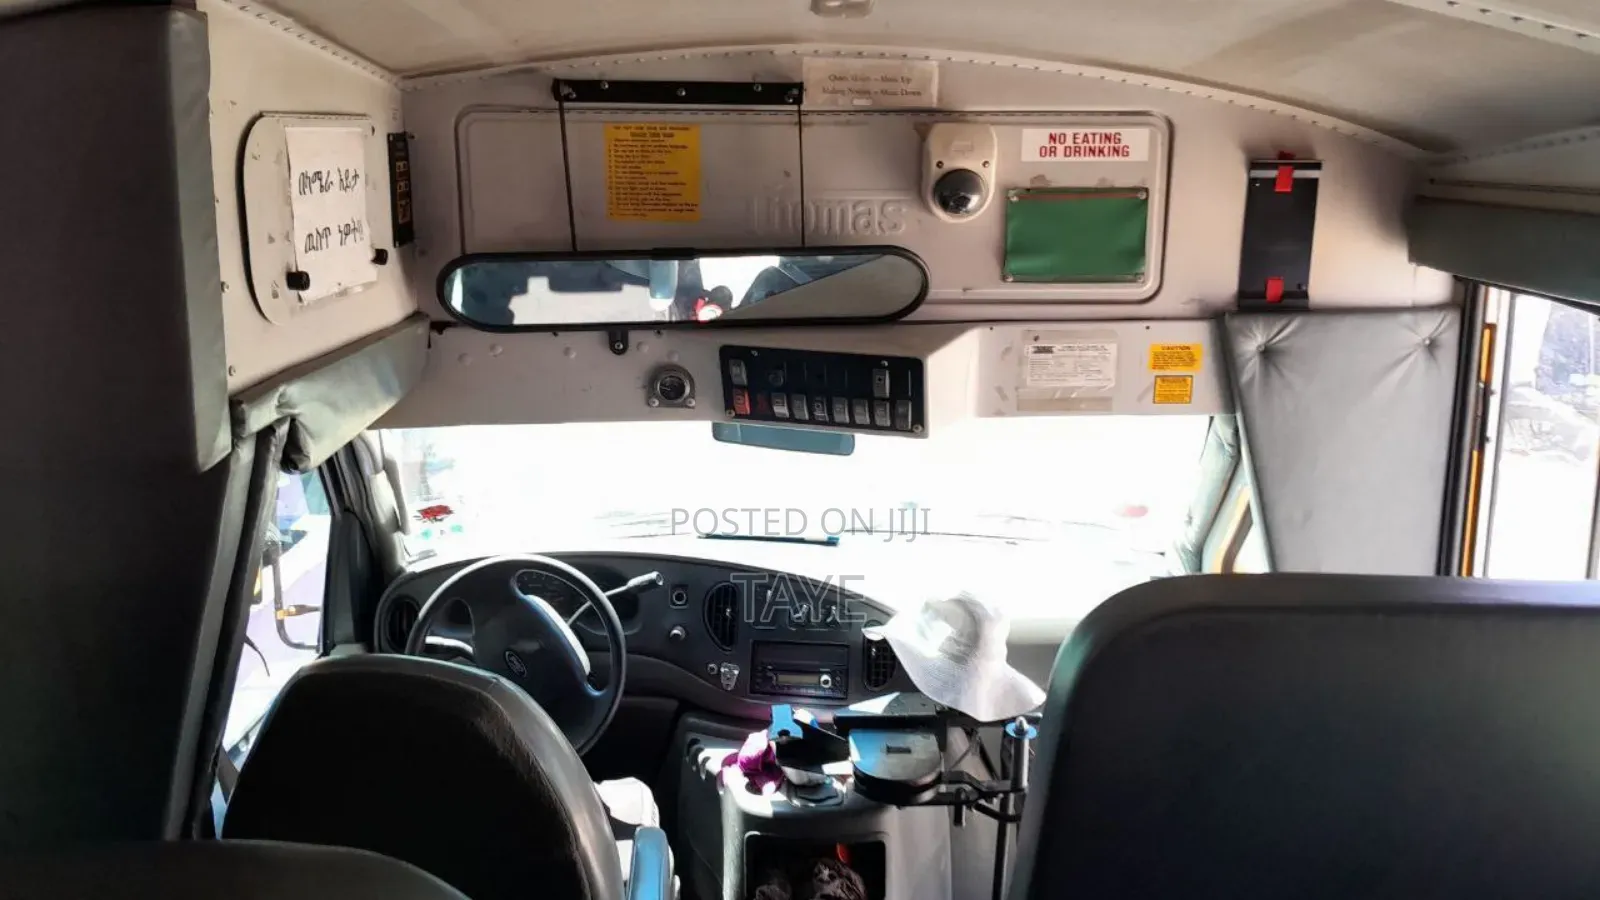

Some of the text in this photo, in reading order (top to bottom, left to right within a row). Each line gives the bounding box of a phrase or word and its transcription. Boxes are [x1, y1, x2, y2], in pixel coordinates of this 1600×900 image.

[1048, 132, 1122, 145] NO EATING
[1039, 145, 1130, 158] OR DRINKING
[745, 194, 907, 236] Thomas
